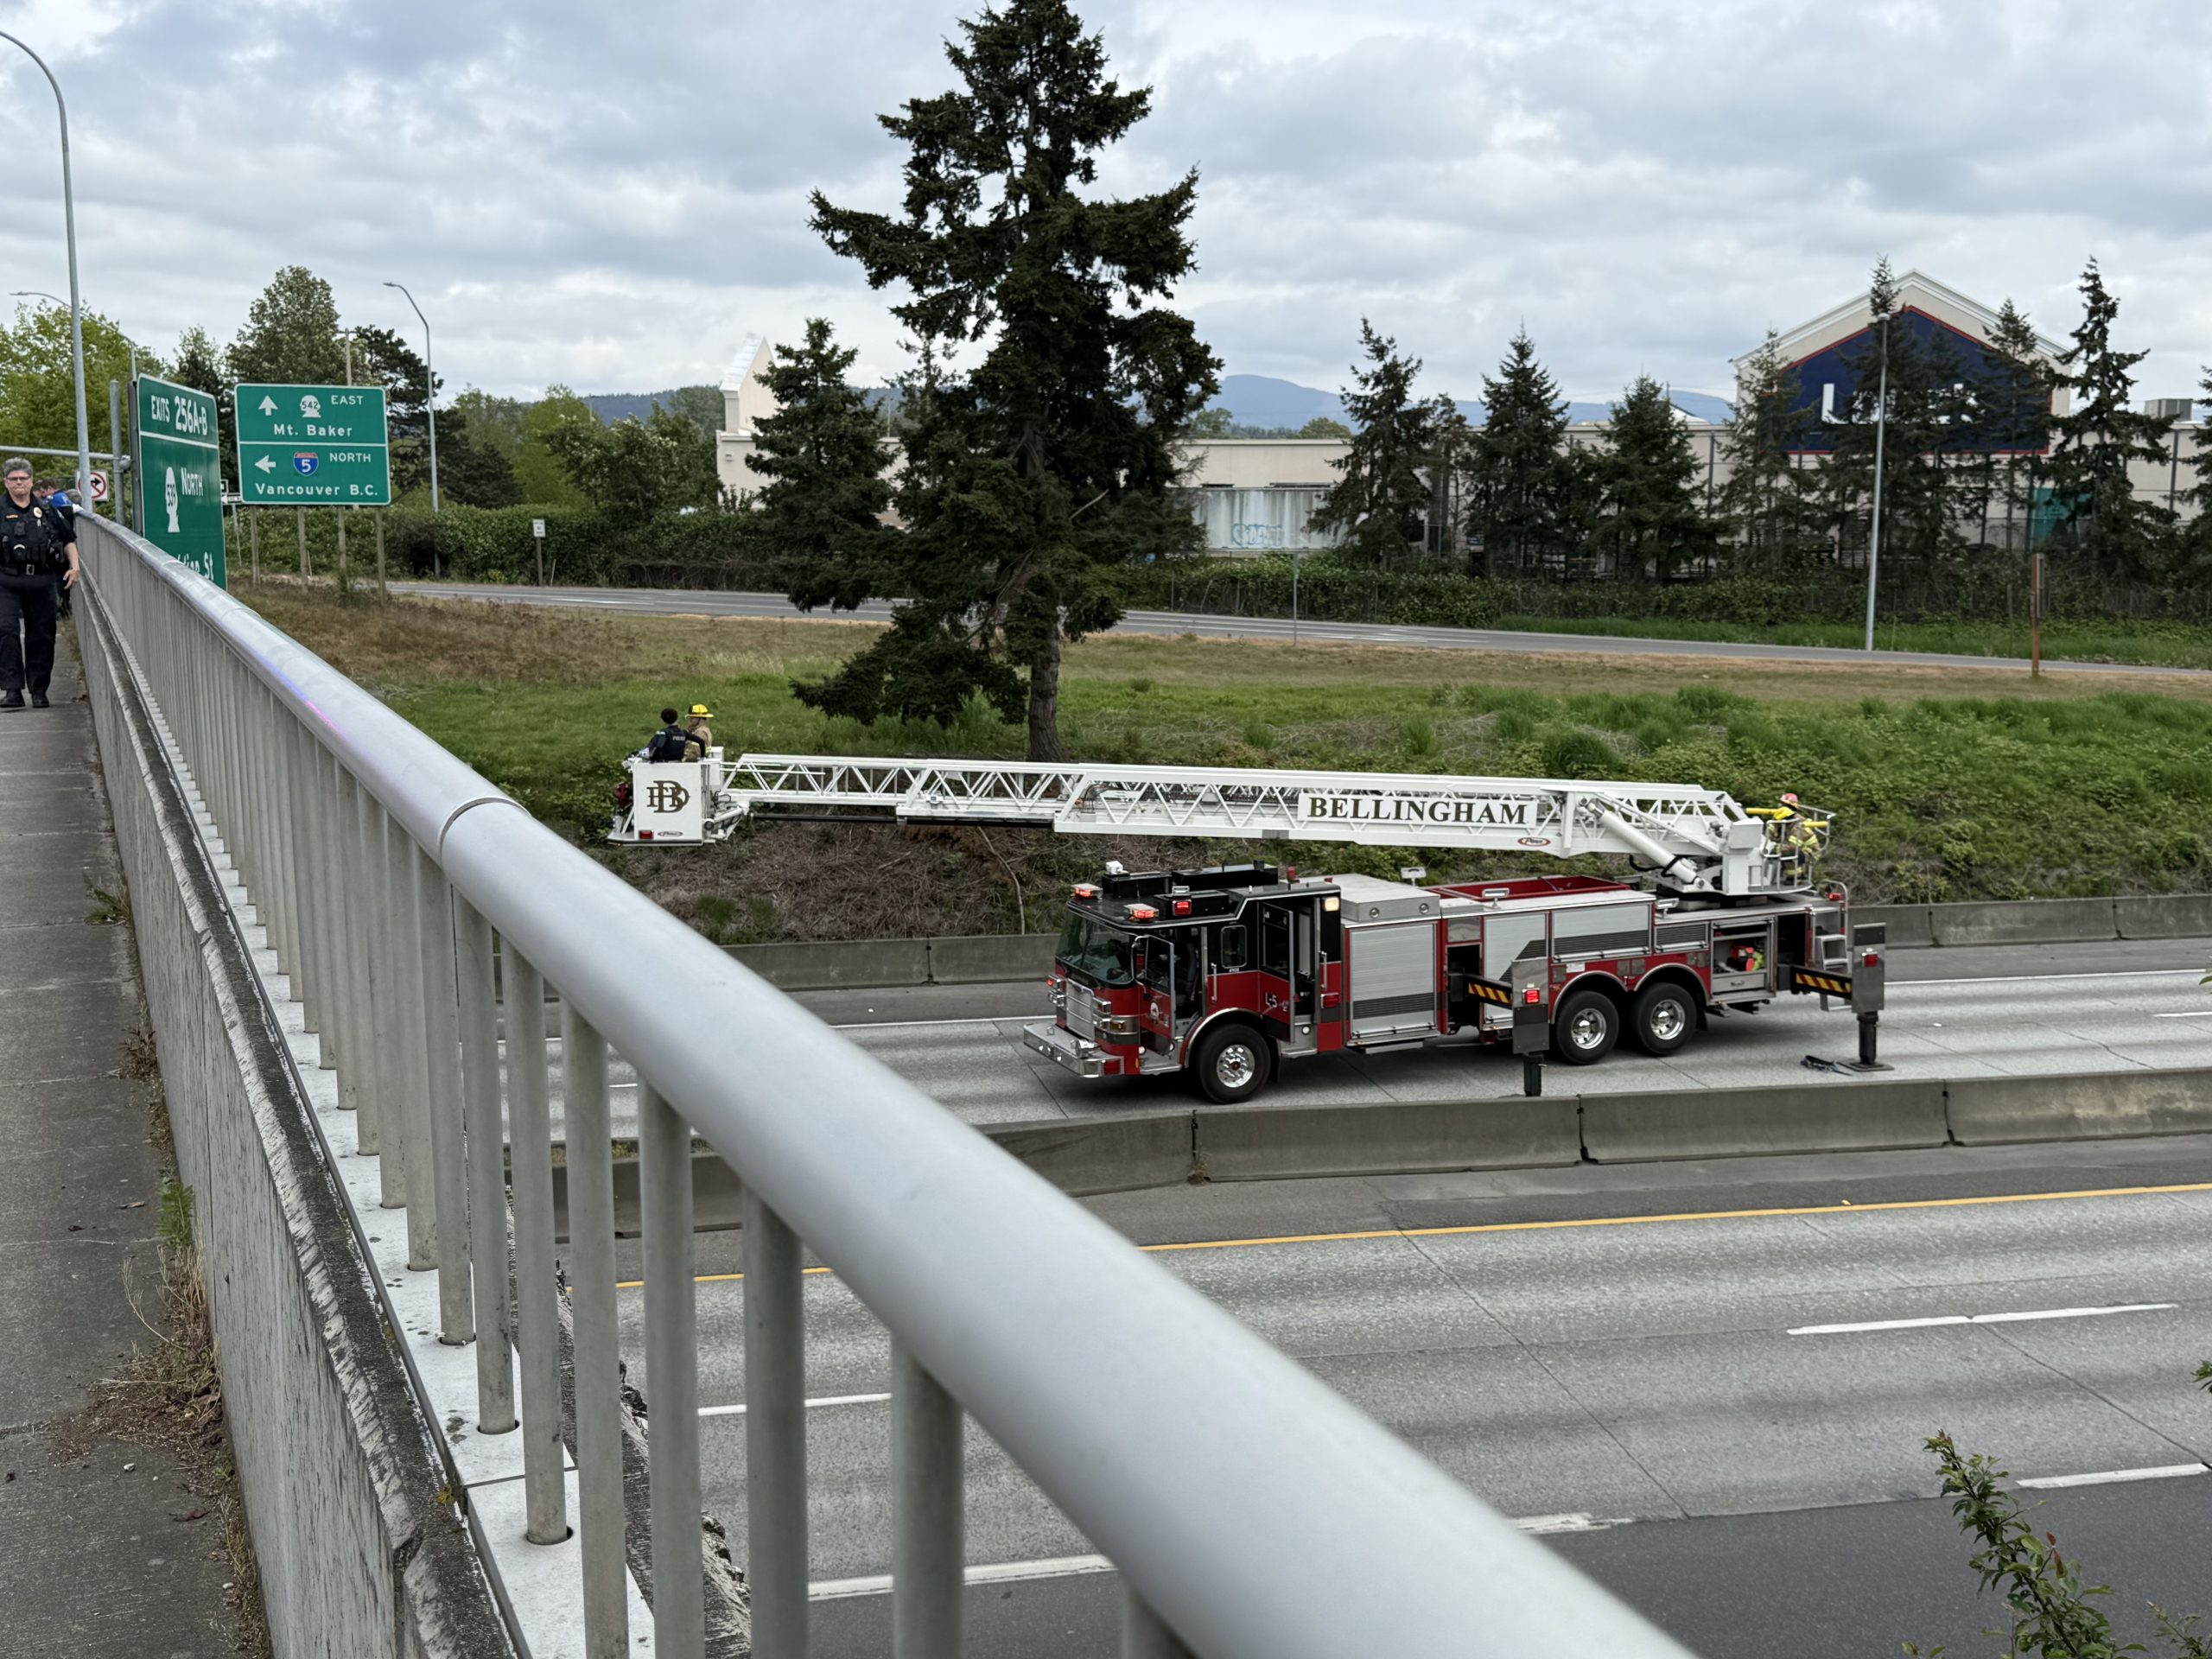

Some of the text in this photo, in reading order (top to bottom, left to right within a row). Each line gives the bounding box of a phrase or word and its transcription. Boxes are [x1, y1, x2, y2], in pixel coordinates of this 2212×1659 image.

[302, 395, 364, 410] 542 EAST
[151, 395, 207, 435] EXITS 256A-B
[274, 423, 353, 436] Mt. Baker
[301, 459, 312, 473] 5
[329, 453, 372, 462] NORTH
[167, 467, 204, 507] 539 NORTH
[255, 483, 378, 496] Vancouver B.C.
[204, 552, 214, 581] St
[1307, 797, 1528, 824] BELLINGHAM
